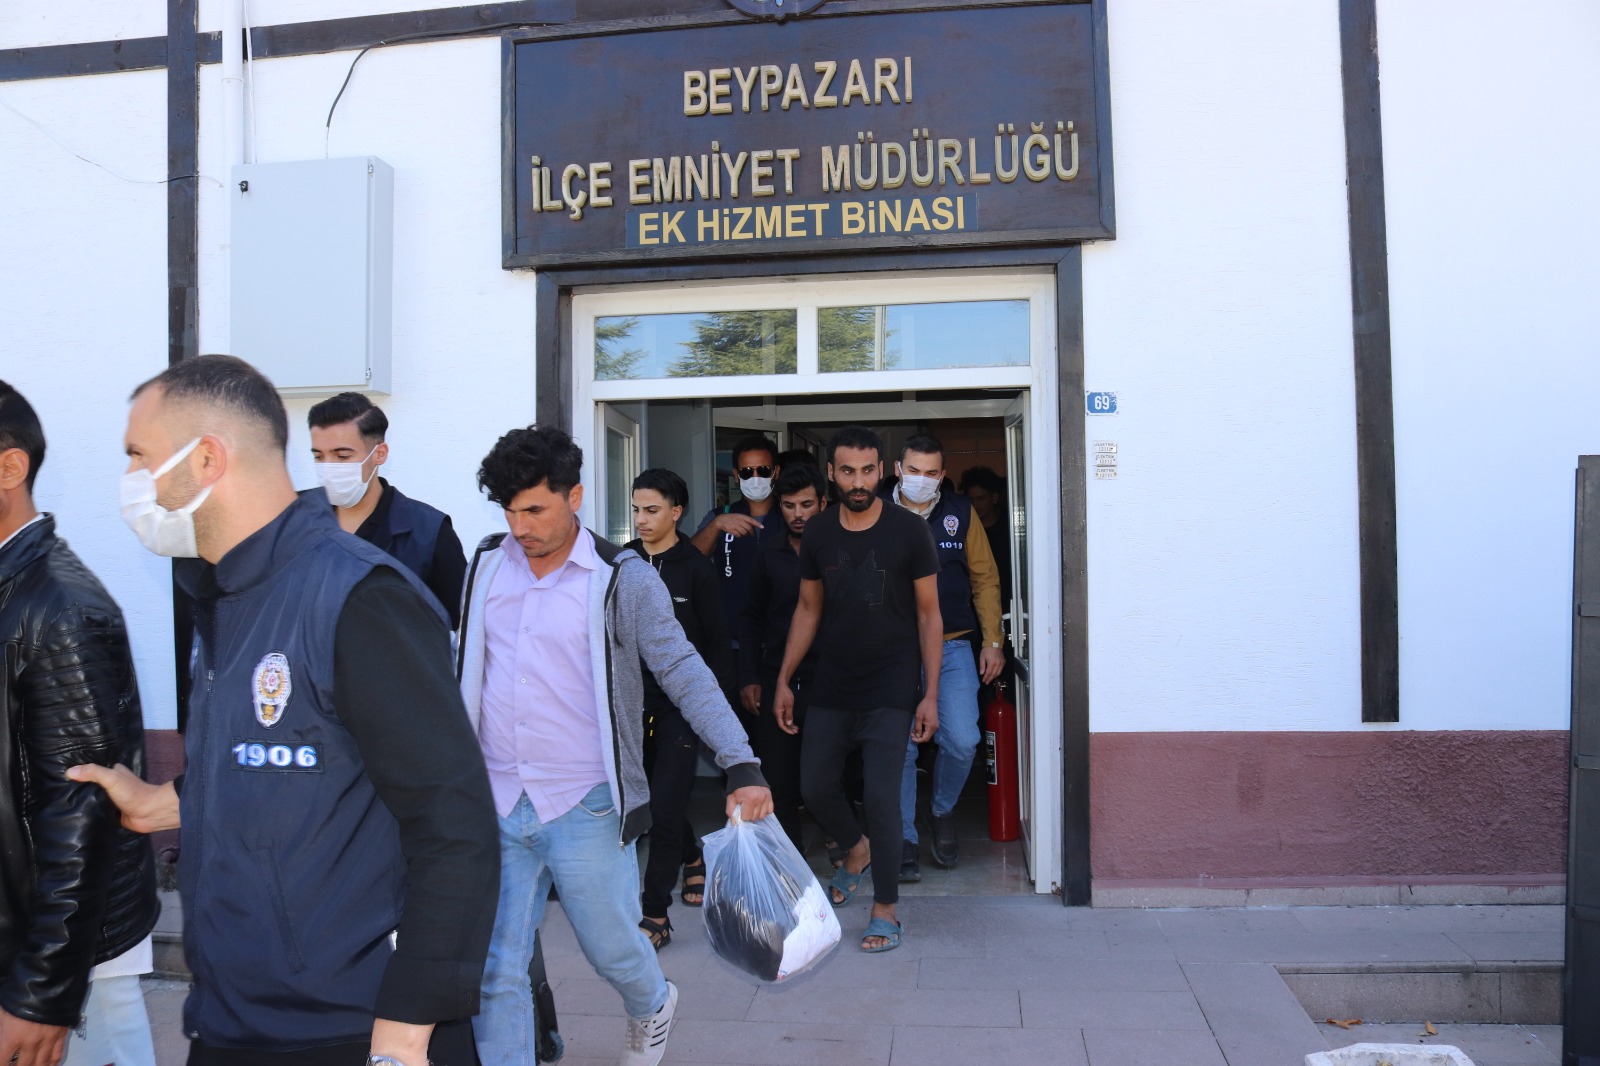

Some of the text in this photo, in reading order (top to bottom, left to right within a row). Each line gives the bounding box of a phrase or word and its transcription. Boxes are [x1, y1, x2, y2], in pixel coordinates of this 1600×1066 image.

[684, 57, 912, 115] BEYPAZARI
[531, 120, 1079, 221] İLÇE EMNİYET MÜDÜRLÜĞÜ
[639, 211, 686, 245] EK
[1094, 395, 1110, 410] 69
[939, 541, 963, 550] 1019
[232, 742, 317, 767] 1906
